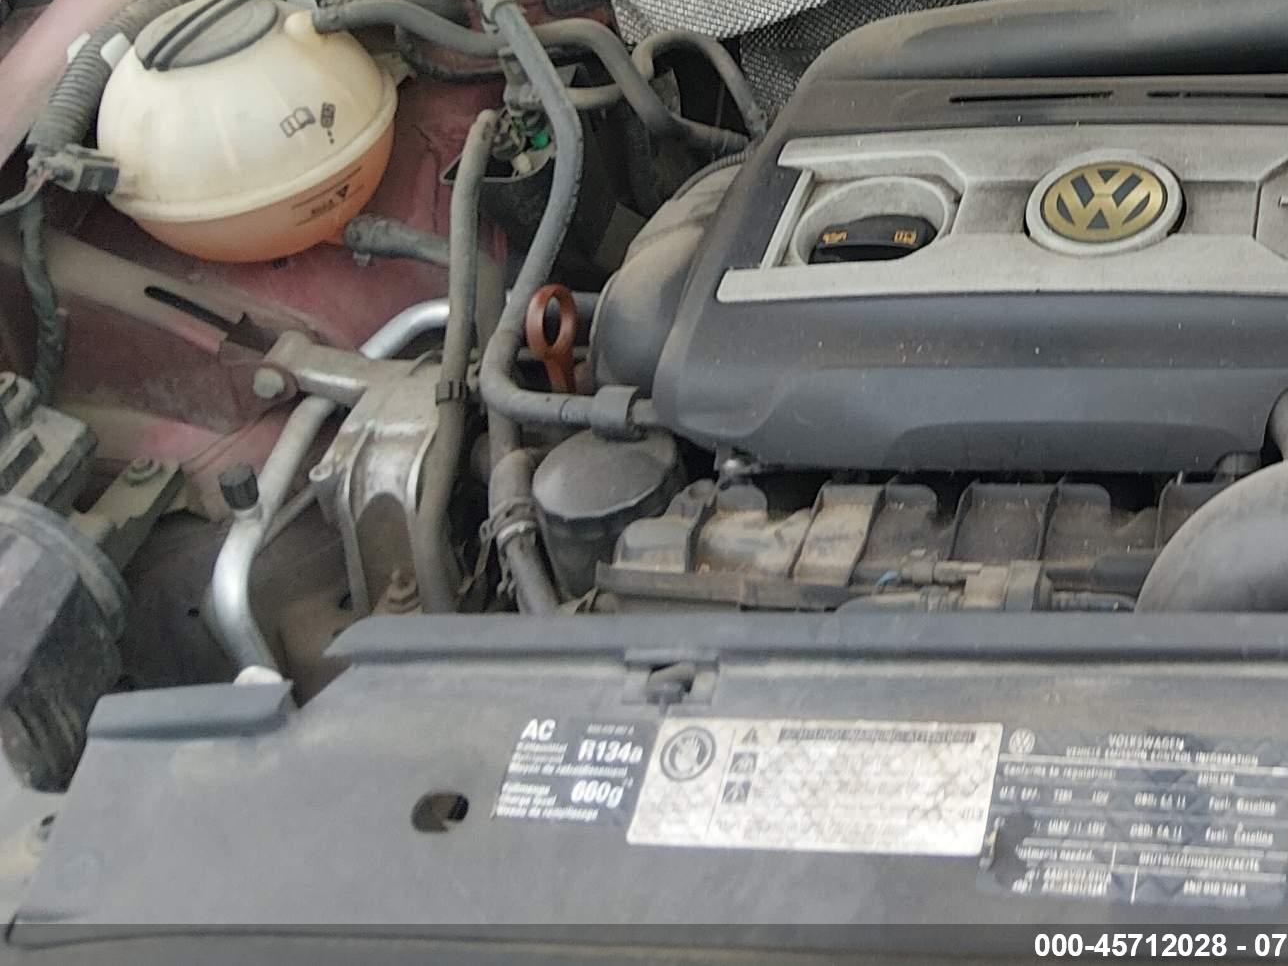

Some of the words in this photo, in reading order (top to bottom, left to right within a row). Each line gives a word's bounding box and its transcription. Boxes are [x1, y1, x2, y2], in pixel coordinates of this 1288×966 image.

[520, 718, 556, 741] AC
[578, 739, 643, 763] R134a
[1108, 733, 1184, 751] VOLKSWAGEN
